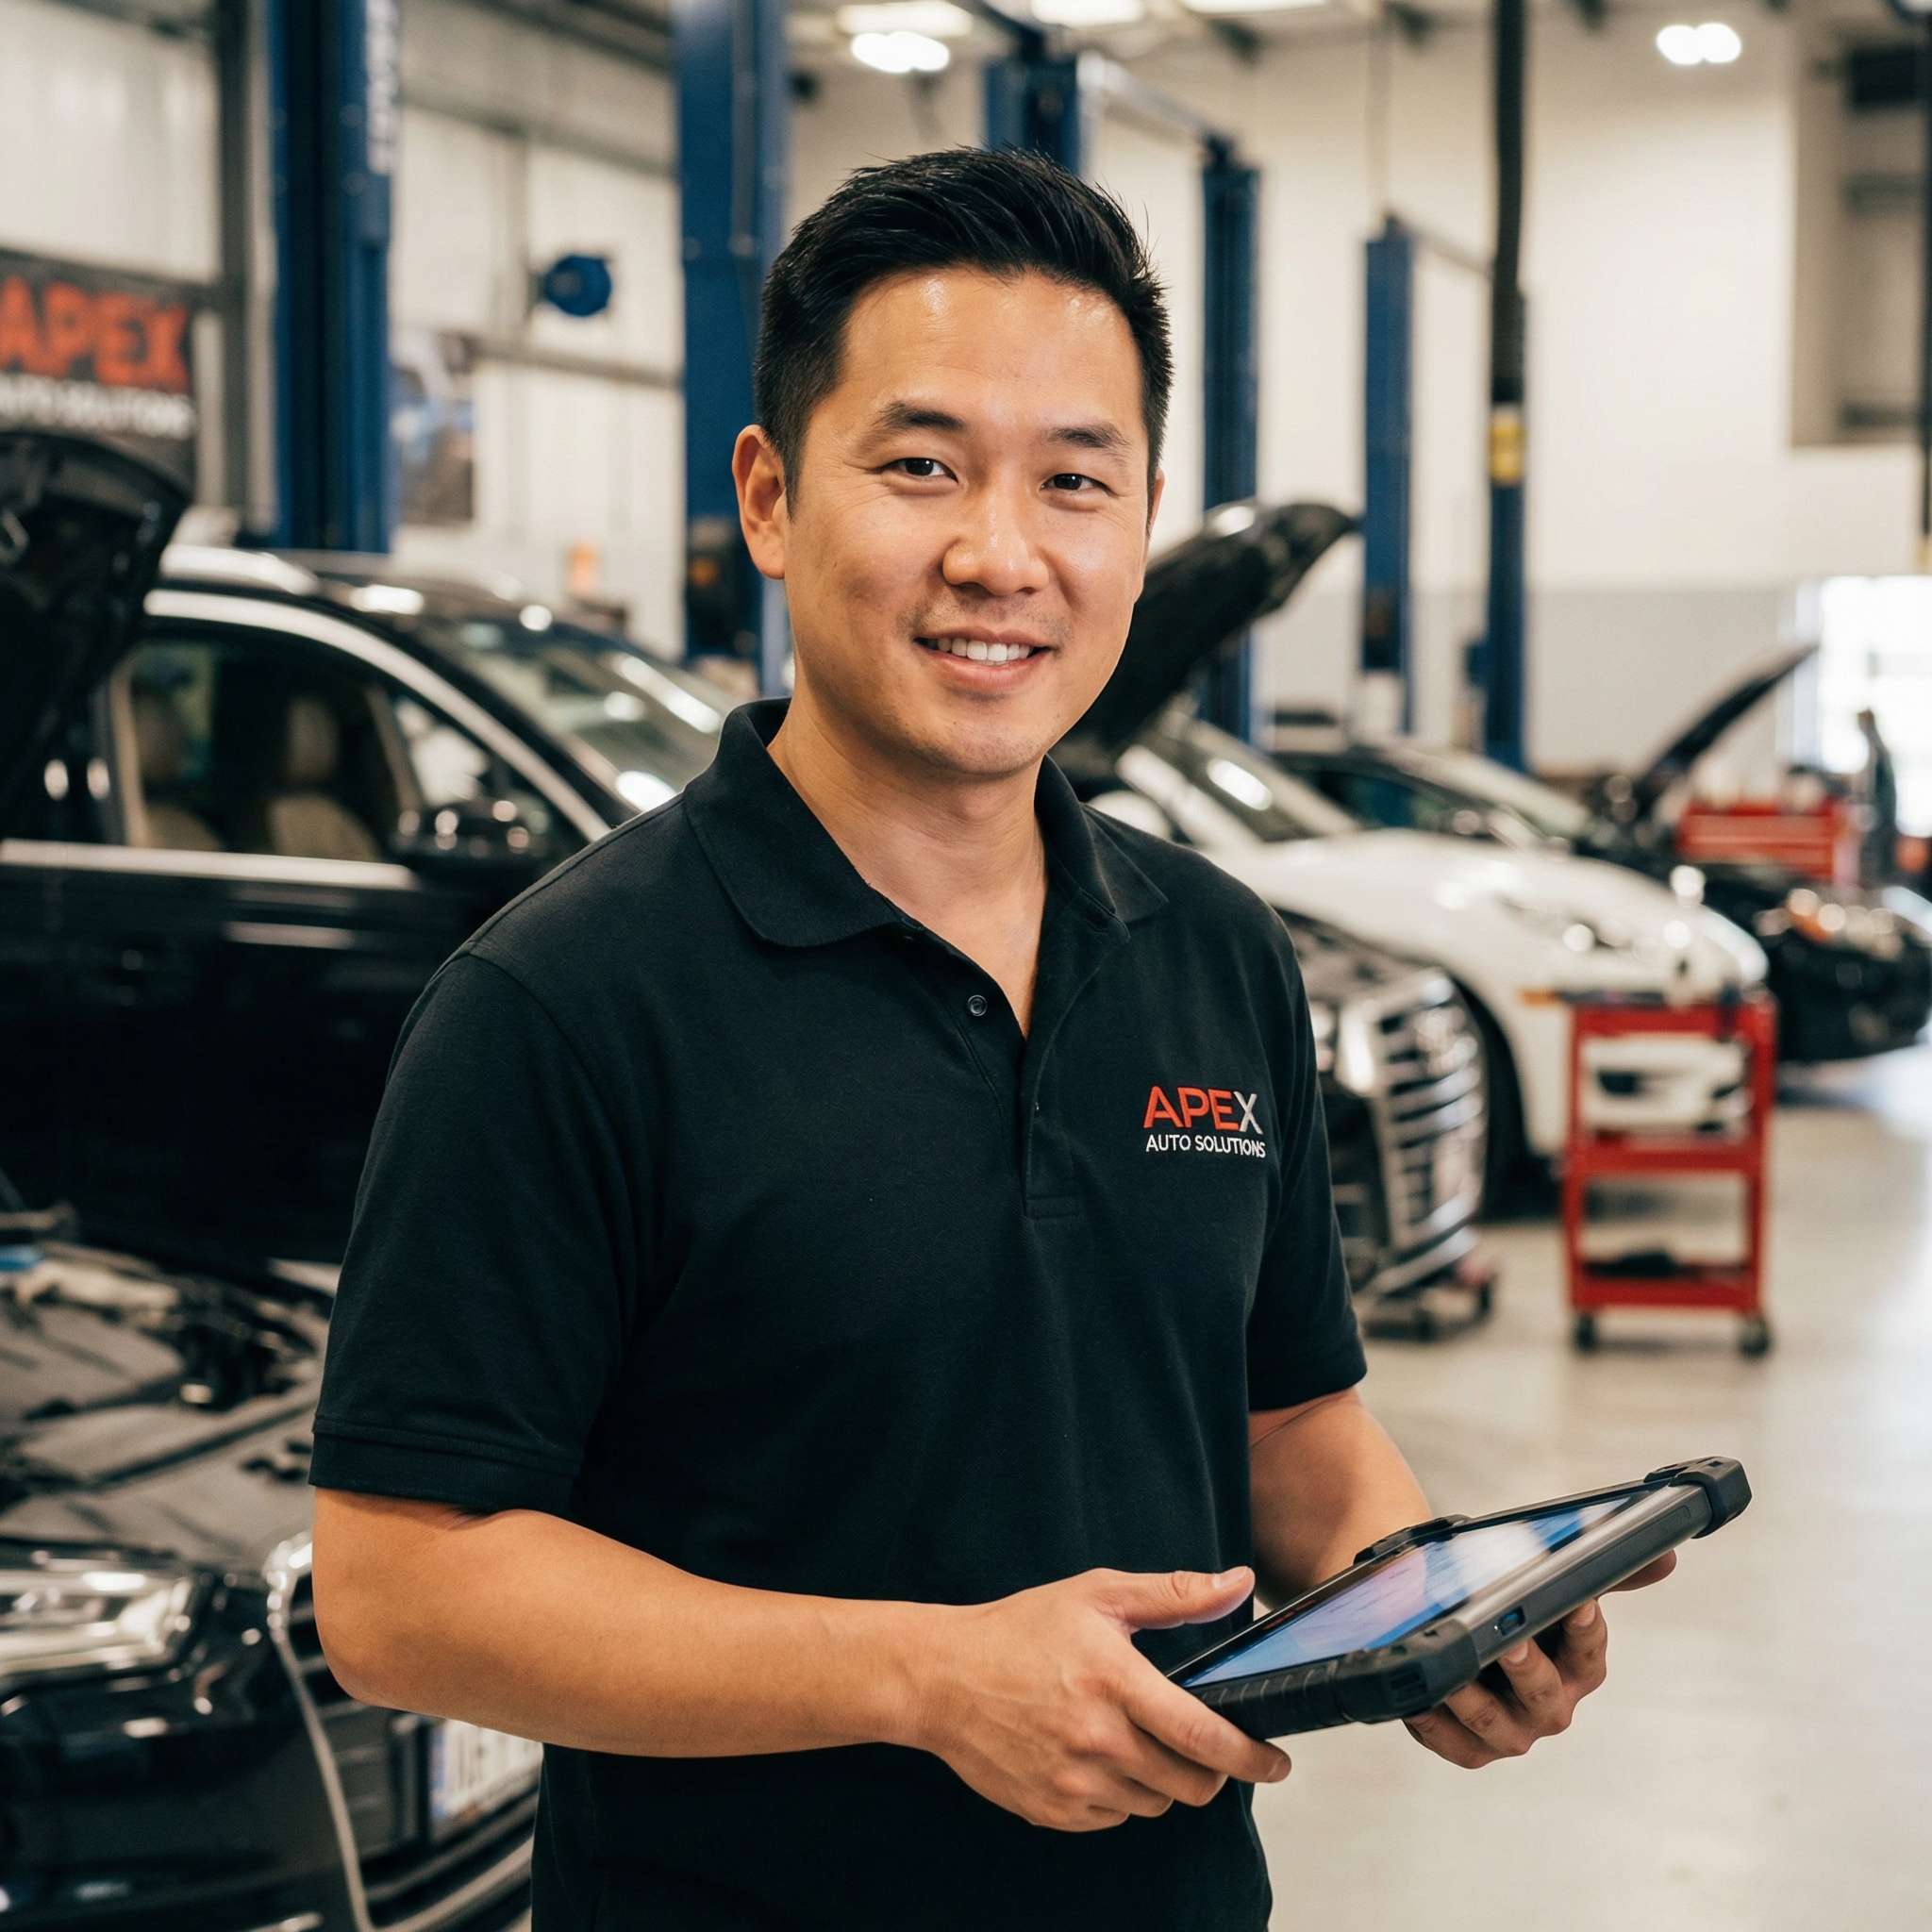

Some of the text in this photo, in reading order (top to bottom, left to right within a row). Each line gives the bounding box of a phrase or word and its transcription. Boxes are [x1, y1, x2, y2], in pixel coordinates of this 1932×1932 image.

[1142, 1085, 1264, 1136] APEX
[1145, 1134, 1266, 1158] AUTO SOLUTIONS
